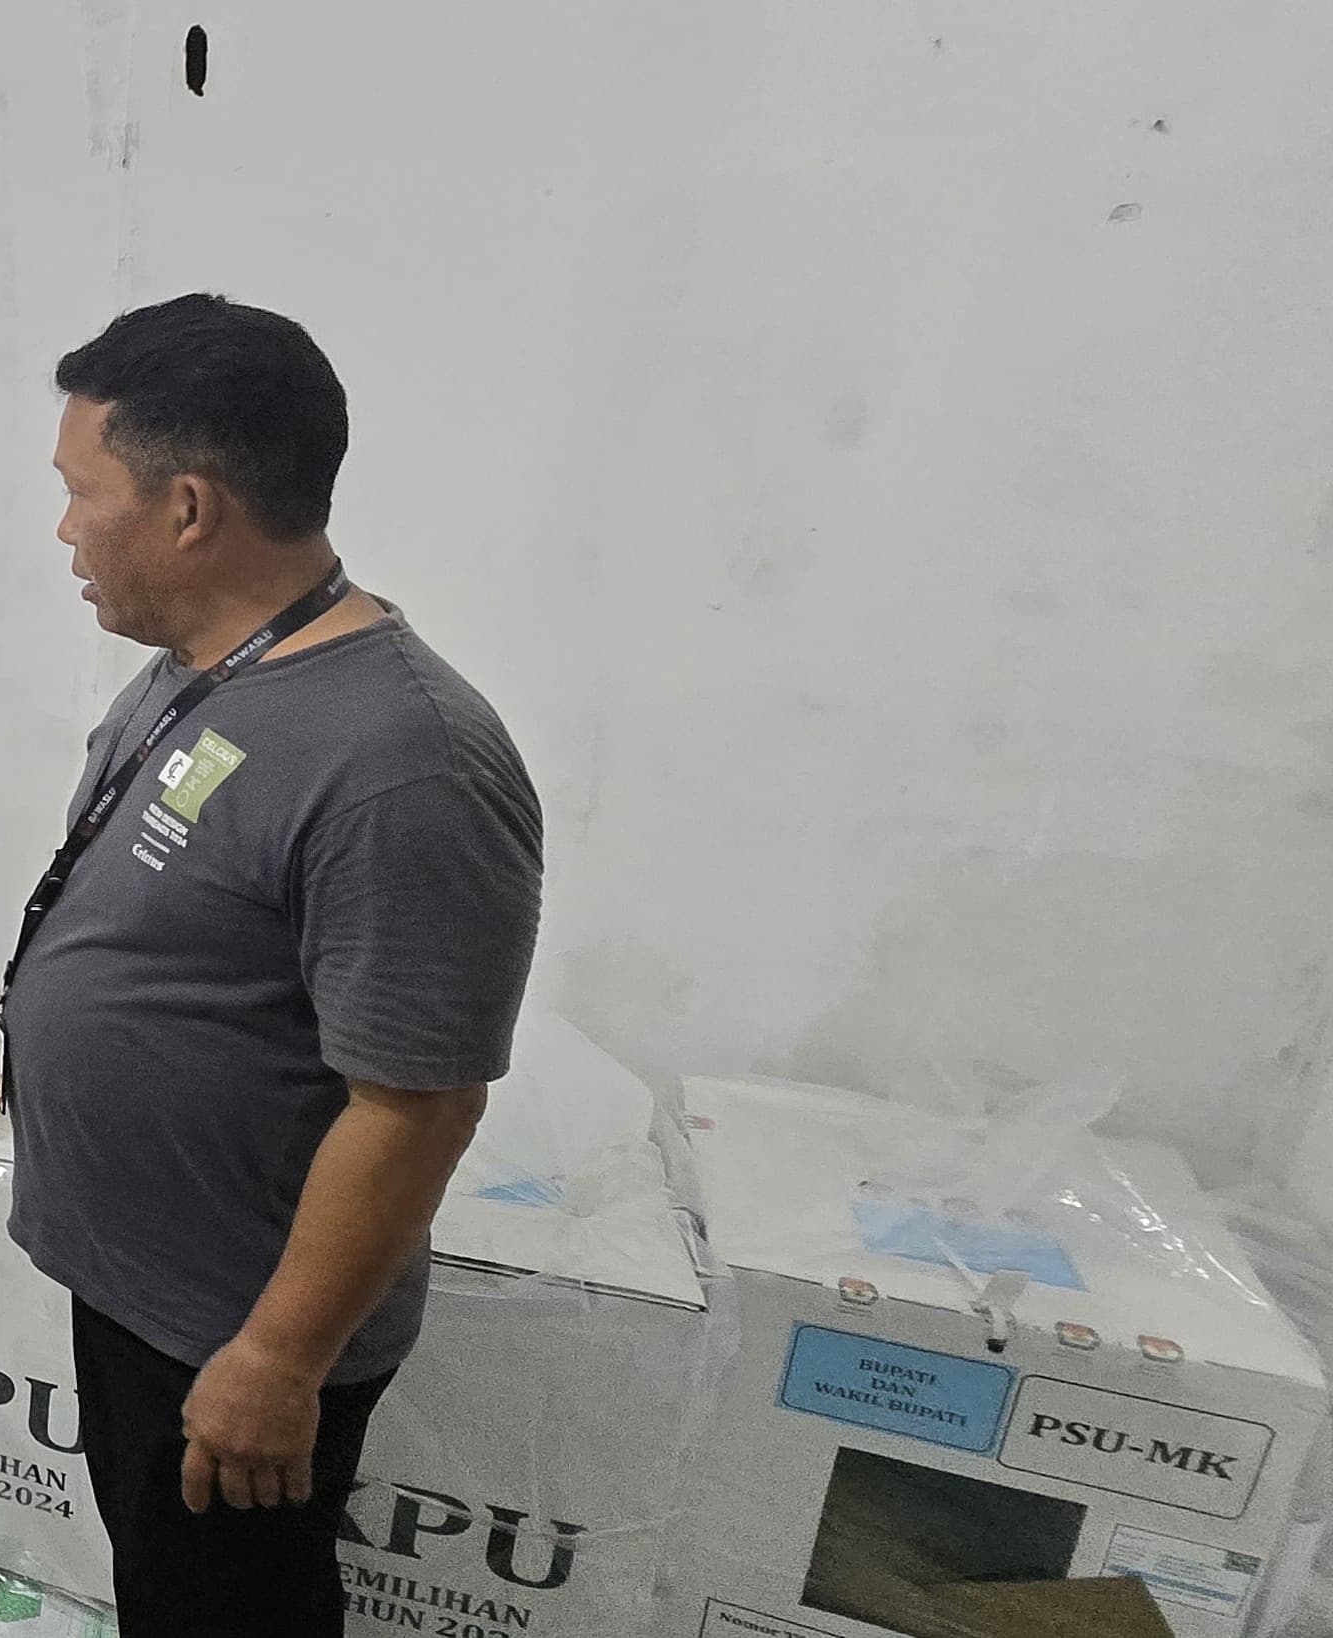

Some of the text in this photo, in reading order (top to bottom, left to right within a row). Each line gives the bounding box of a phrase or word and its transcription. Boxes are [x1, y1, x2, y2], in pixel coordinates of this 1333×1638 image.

[225, 629, 274, 668] BAWASLU
[859, 1358, 938, 1386] BUPATI
[871, 1377, 918, 1398] DAN
[815, 1382, 968, 1428] WAKIL BUPATI
[1028, 1412, 1239, 1481] PSU-MK
[340, 1562, 533, 1630] EMILIHAN
[345, 1594, 426, 1630] HUN
